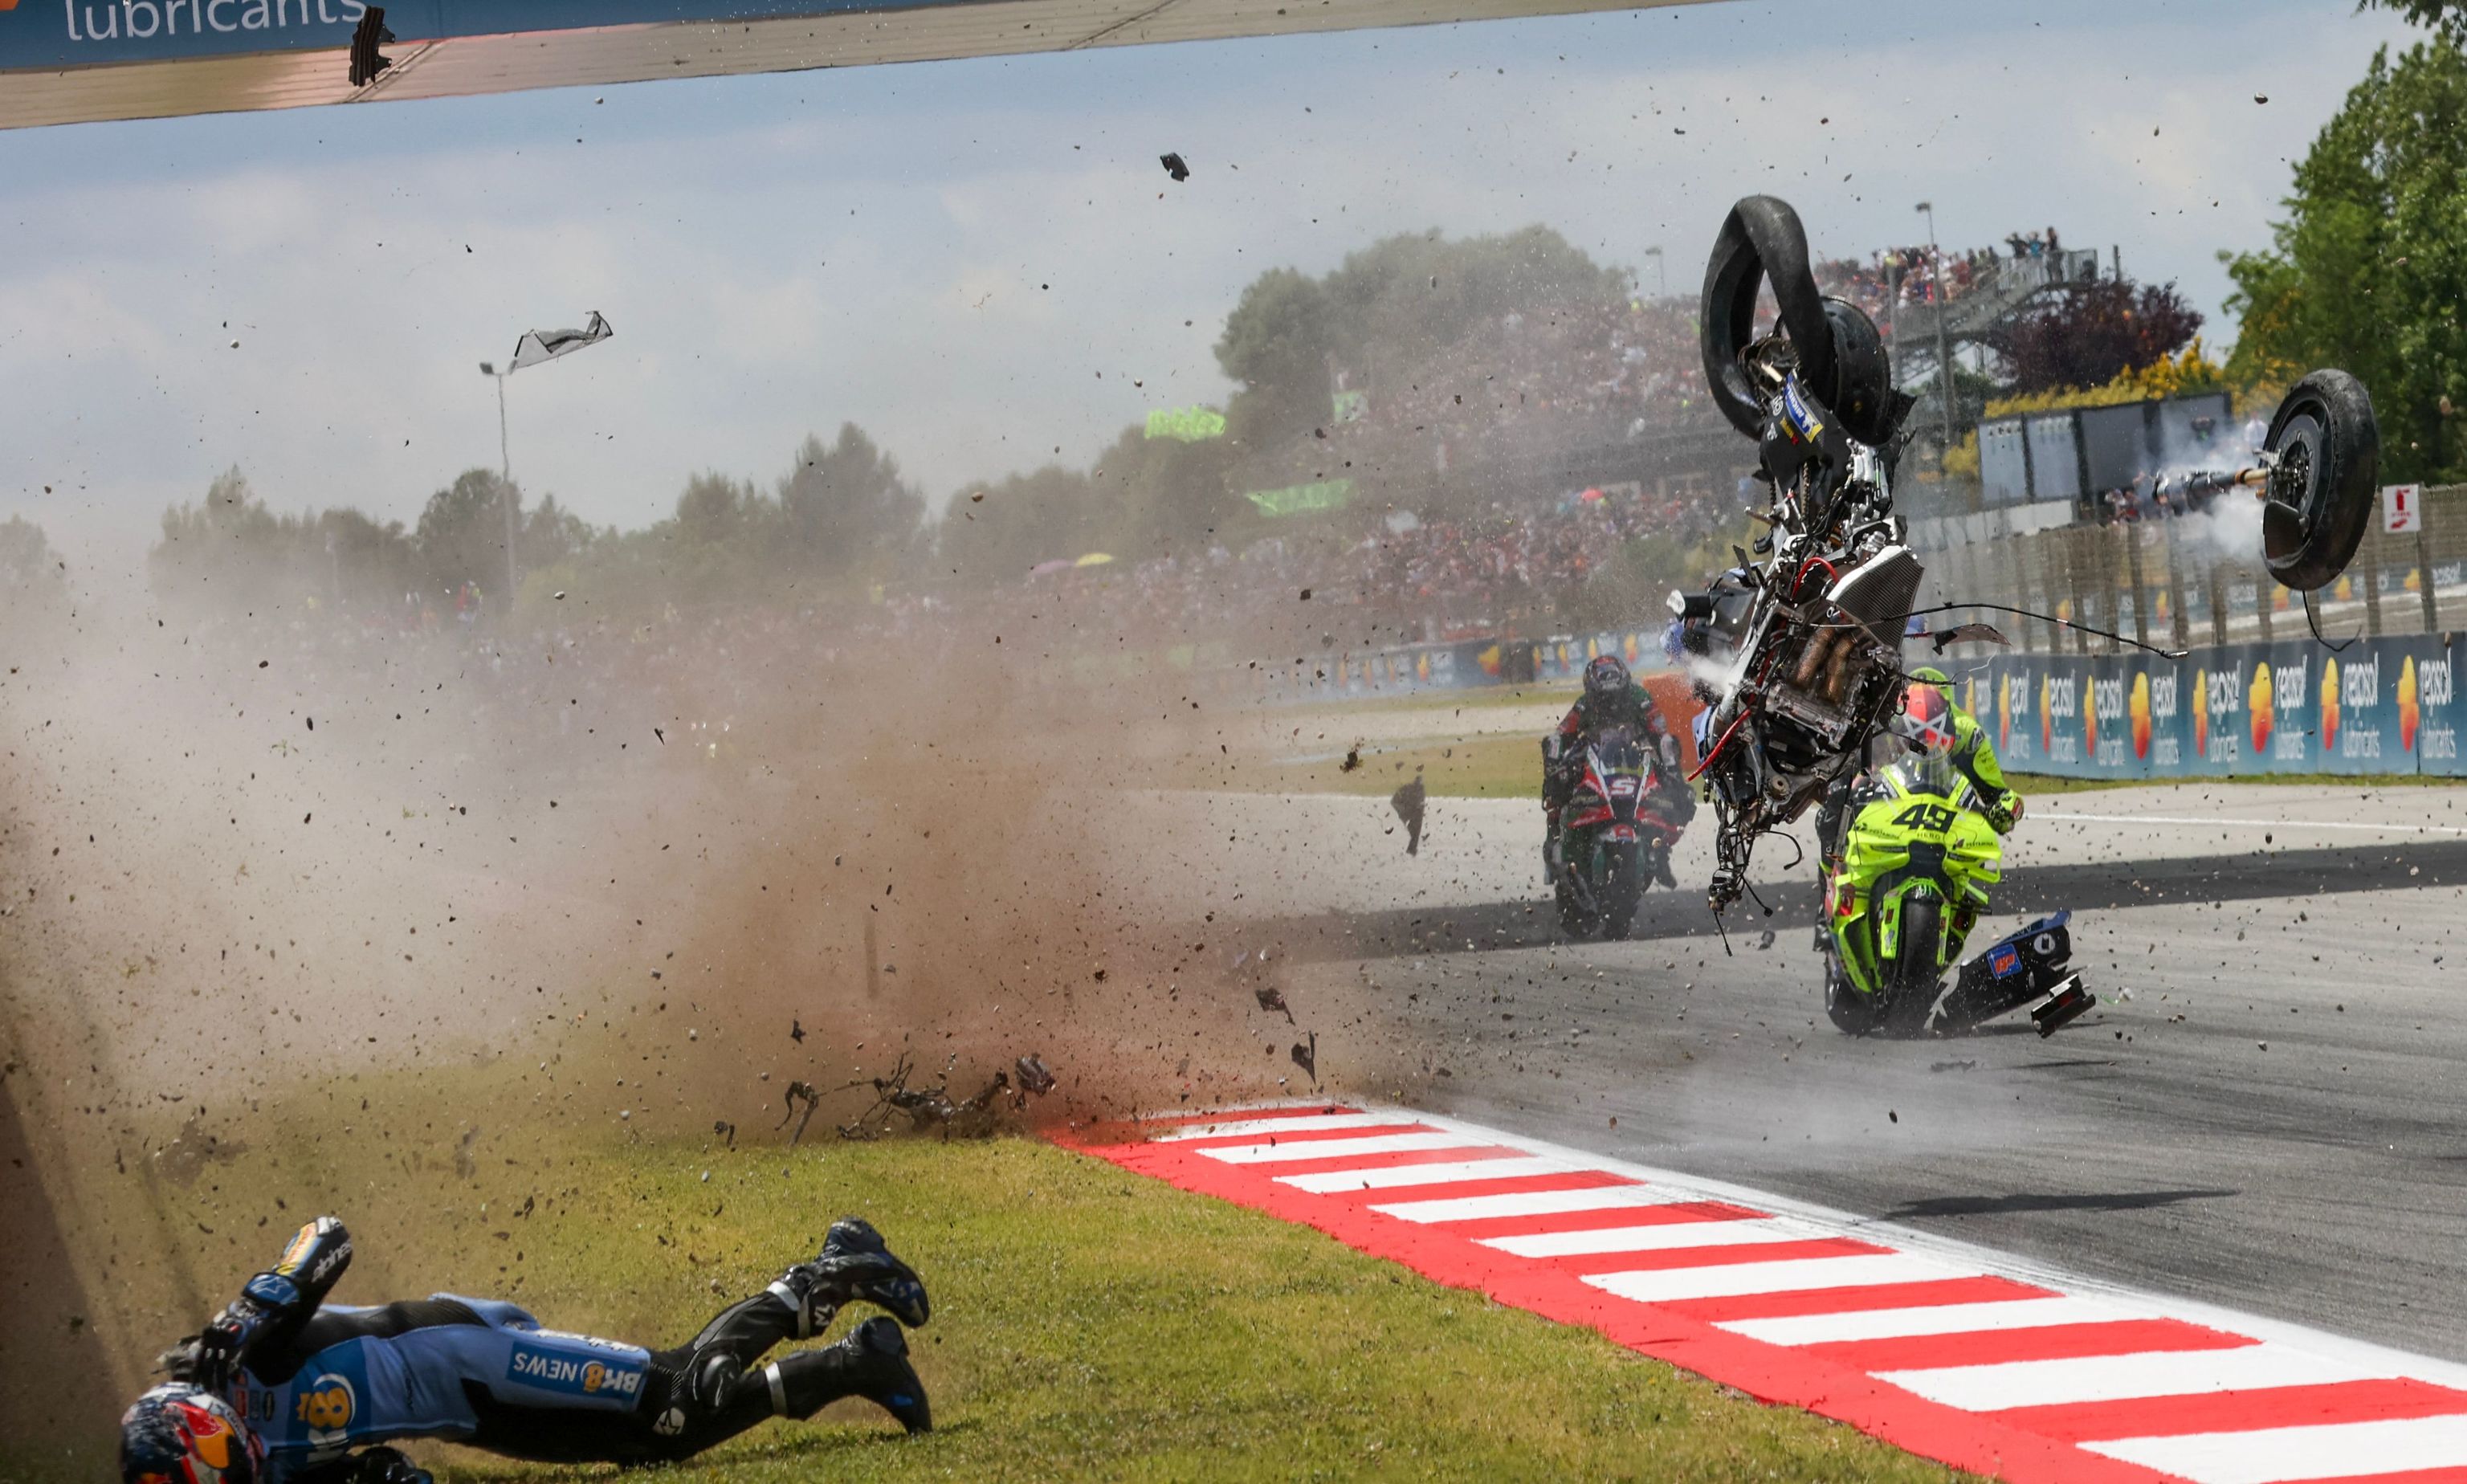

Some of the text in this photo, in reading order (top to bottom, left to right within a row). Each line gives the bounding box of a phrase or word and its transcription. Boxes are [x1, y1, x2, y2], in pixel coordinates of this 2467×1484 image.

[1891, 803, 1957, 834] 49
[513, 1352, 642, 1393] BK8 NEWS
